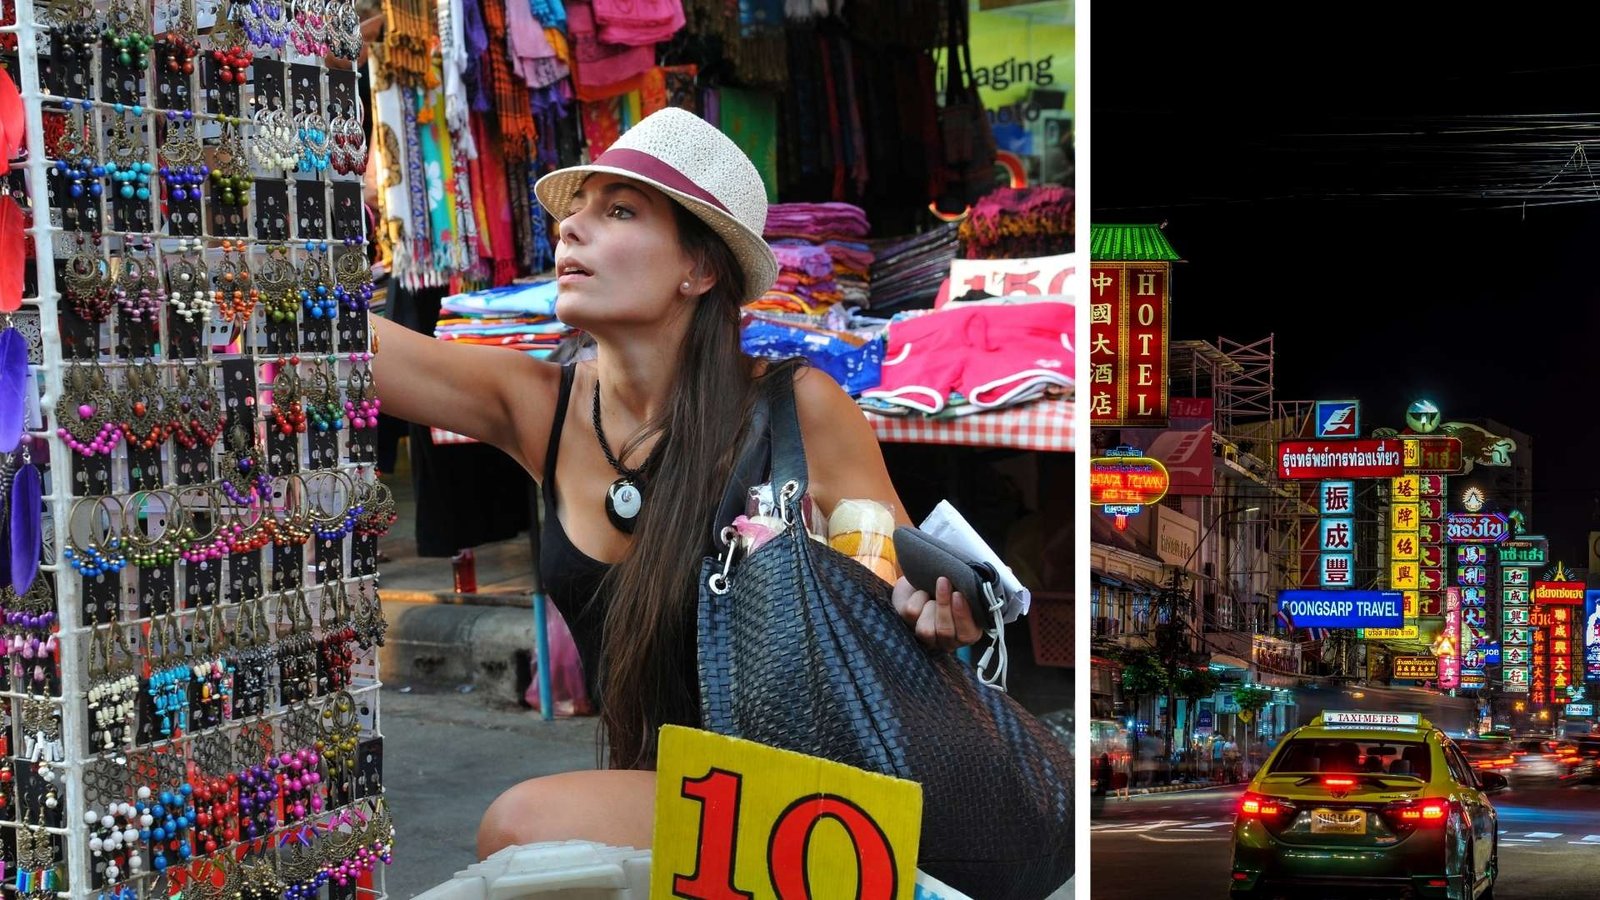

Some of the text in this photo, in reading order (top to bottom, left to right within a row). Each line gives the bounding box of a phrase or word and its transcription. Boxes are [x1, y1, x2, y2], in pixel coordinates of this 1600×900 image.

[939, 55, 1054, 92] iaging
[1090, 271, 1115, 416] 中國大酒店
[1137, 273, 1156, 416] HOTEL
[1282, 441, 1400, 475] รุ่งทรัพย์การท่องเที่ยว
[1325, 486, 1349, 583] 振成豐
[1447, 518, 1502, 537] ทองใบ
[1356, 601, 1399, 617] TRAVEL
[1464, 546, 1481, 667] 馬利興大行
[1554, 608, 1567, 687] 聯成興大金
[672, 767, 898, 900] 10
